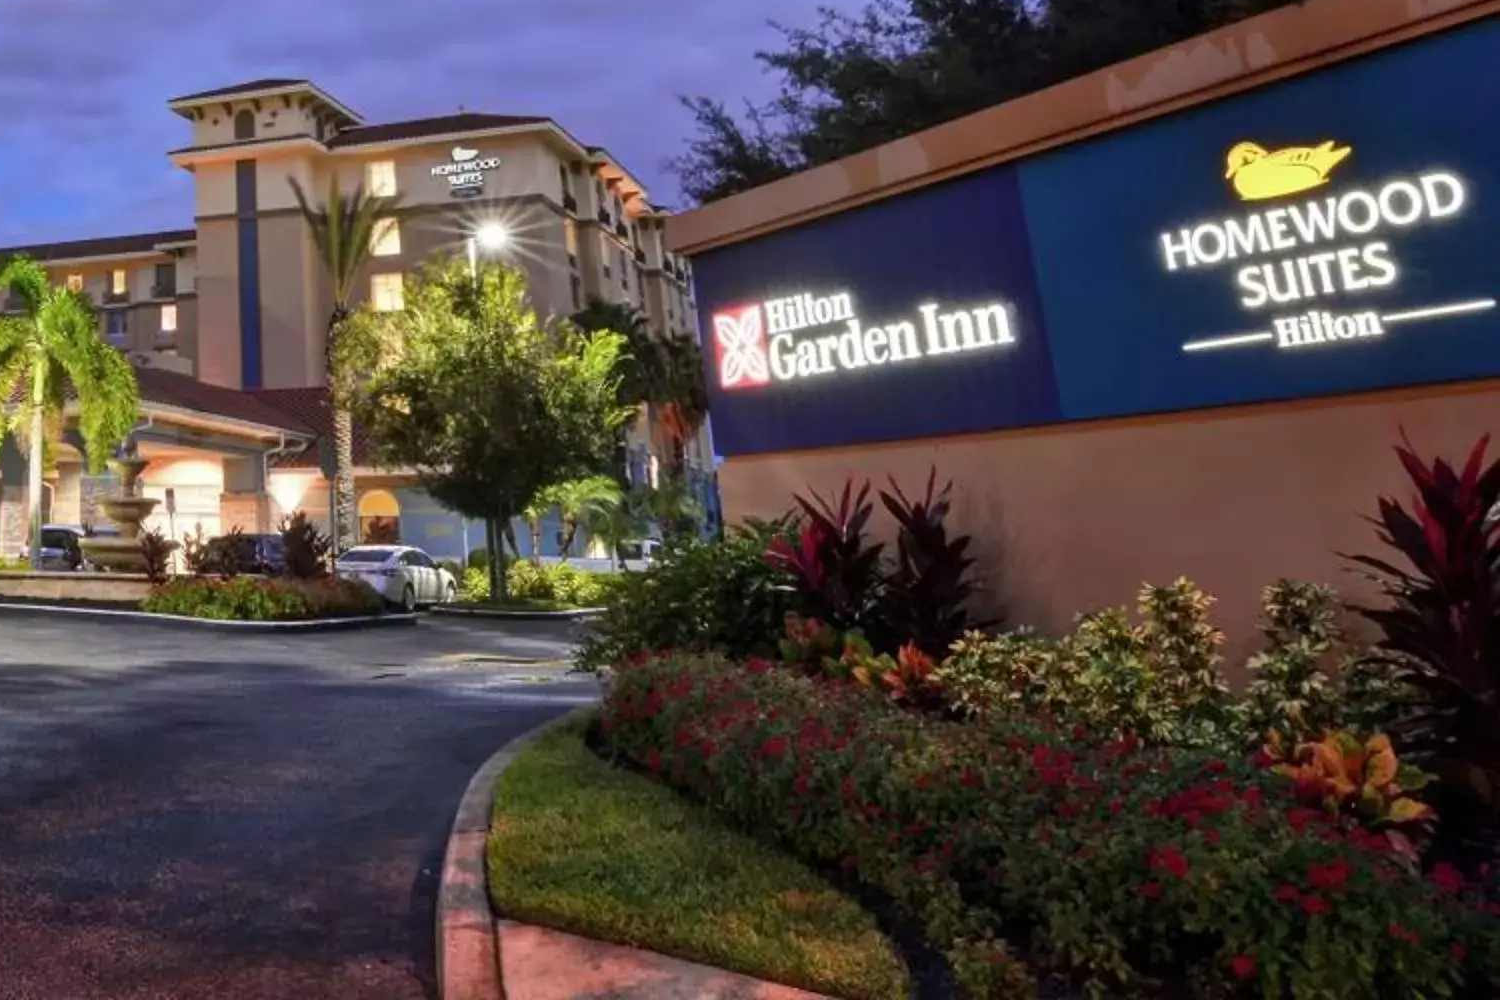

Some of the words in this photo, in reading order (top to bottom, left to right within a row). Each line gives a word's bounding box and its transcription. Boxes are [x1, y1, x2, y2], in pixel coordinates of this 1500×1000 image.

[1160, 173, 1464, 271] HOMEWOOD
[1236, 241, 1397, 307] SUITES
[764, 291, 854, 335] Hilton
[769, 318, 922, 380] Garden
[917, 301, 1016, 356] Inn
[1271, 310, 1384, 348] Hilton
